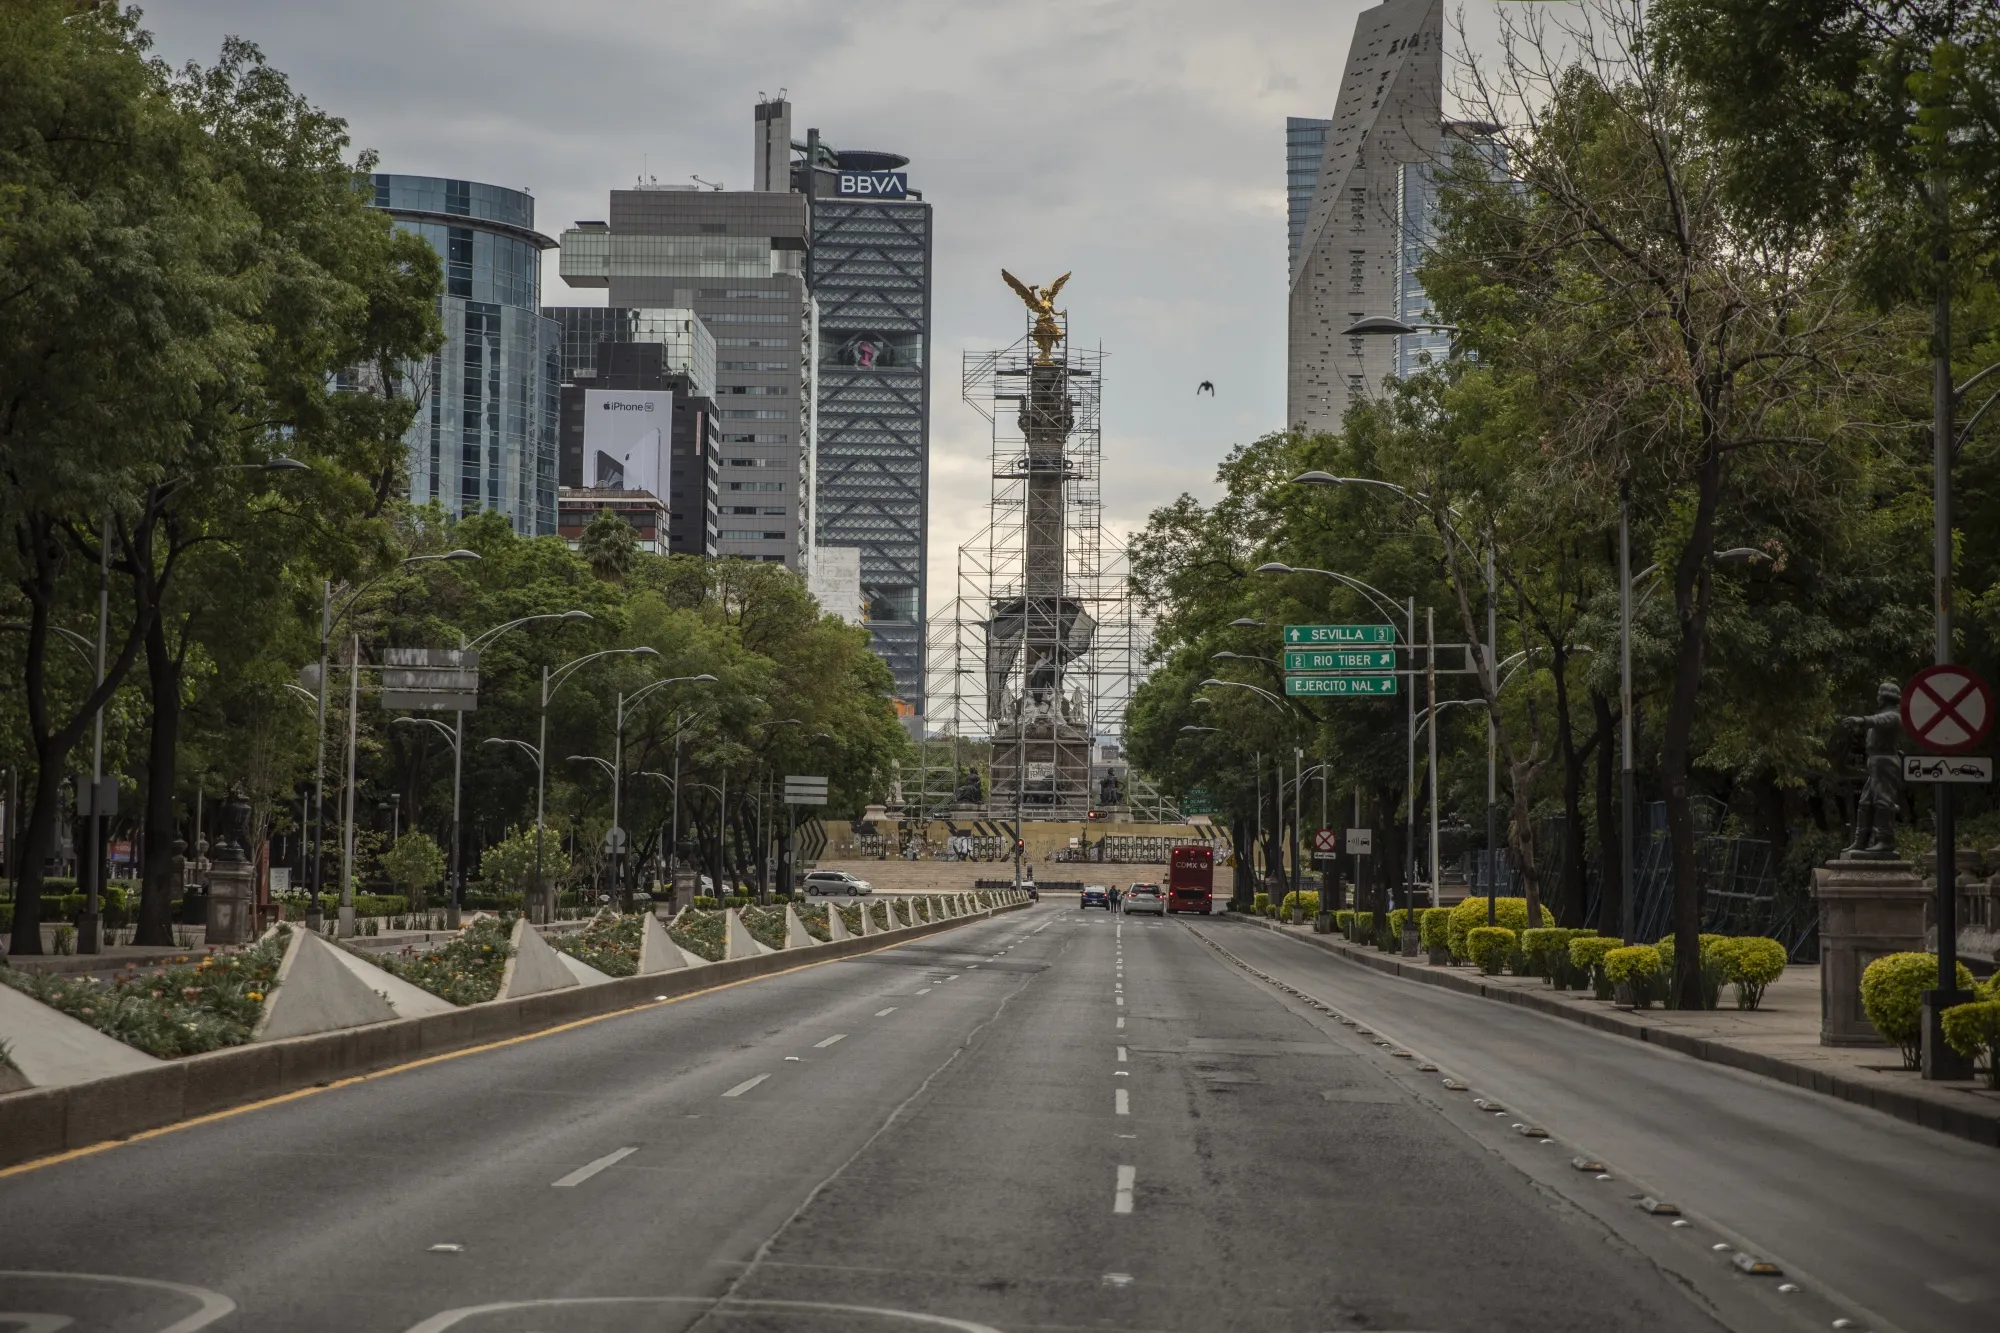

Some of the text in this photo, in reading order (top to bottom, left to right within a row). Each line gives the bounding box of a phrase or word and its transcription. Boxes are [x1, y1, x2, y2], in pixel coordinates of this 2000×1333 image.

[841, 175, 904, 194] BBVA
[611, 402, 643, 411] iPhone
[1311, 629, 1364, 640] SEVILLA
[1314, 655, 1333, 666] RIO
[1338, 655, 1371, 665] TIBER
[1295, 680, 1374, 691] EJERCITO NAL
